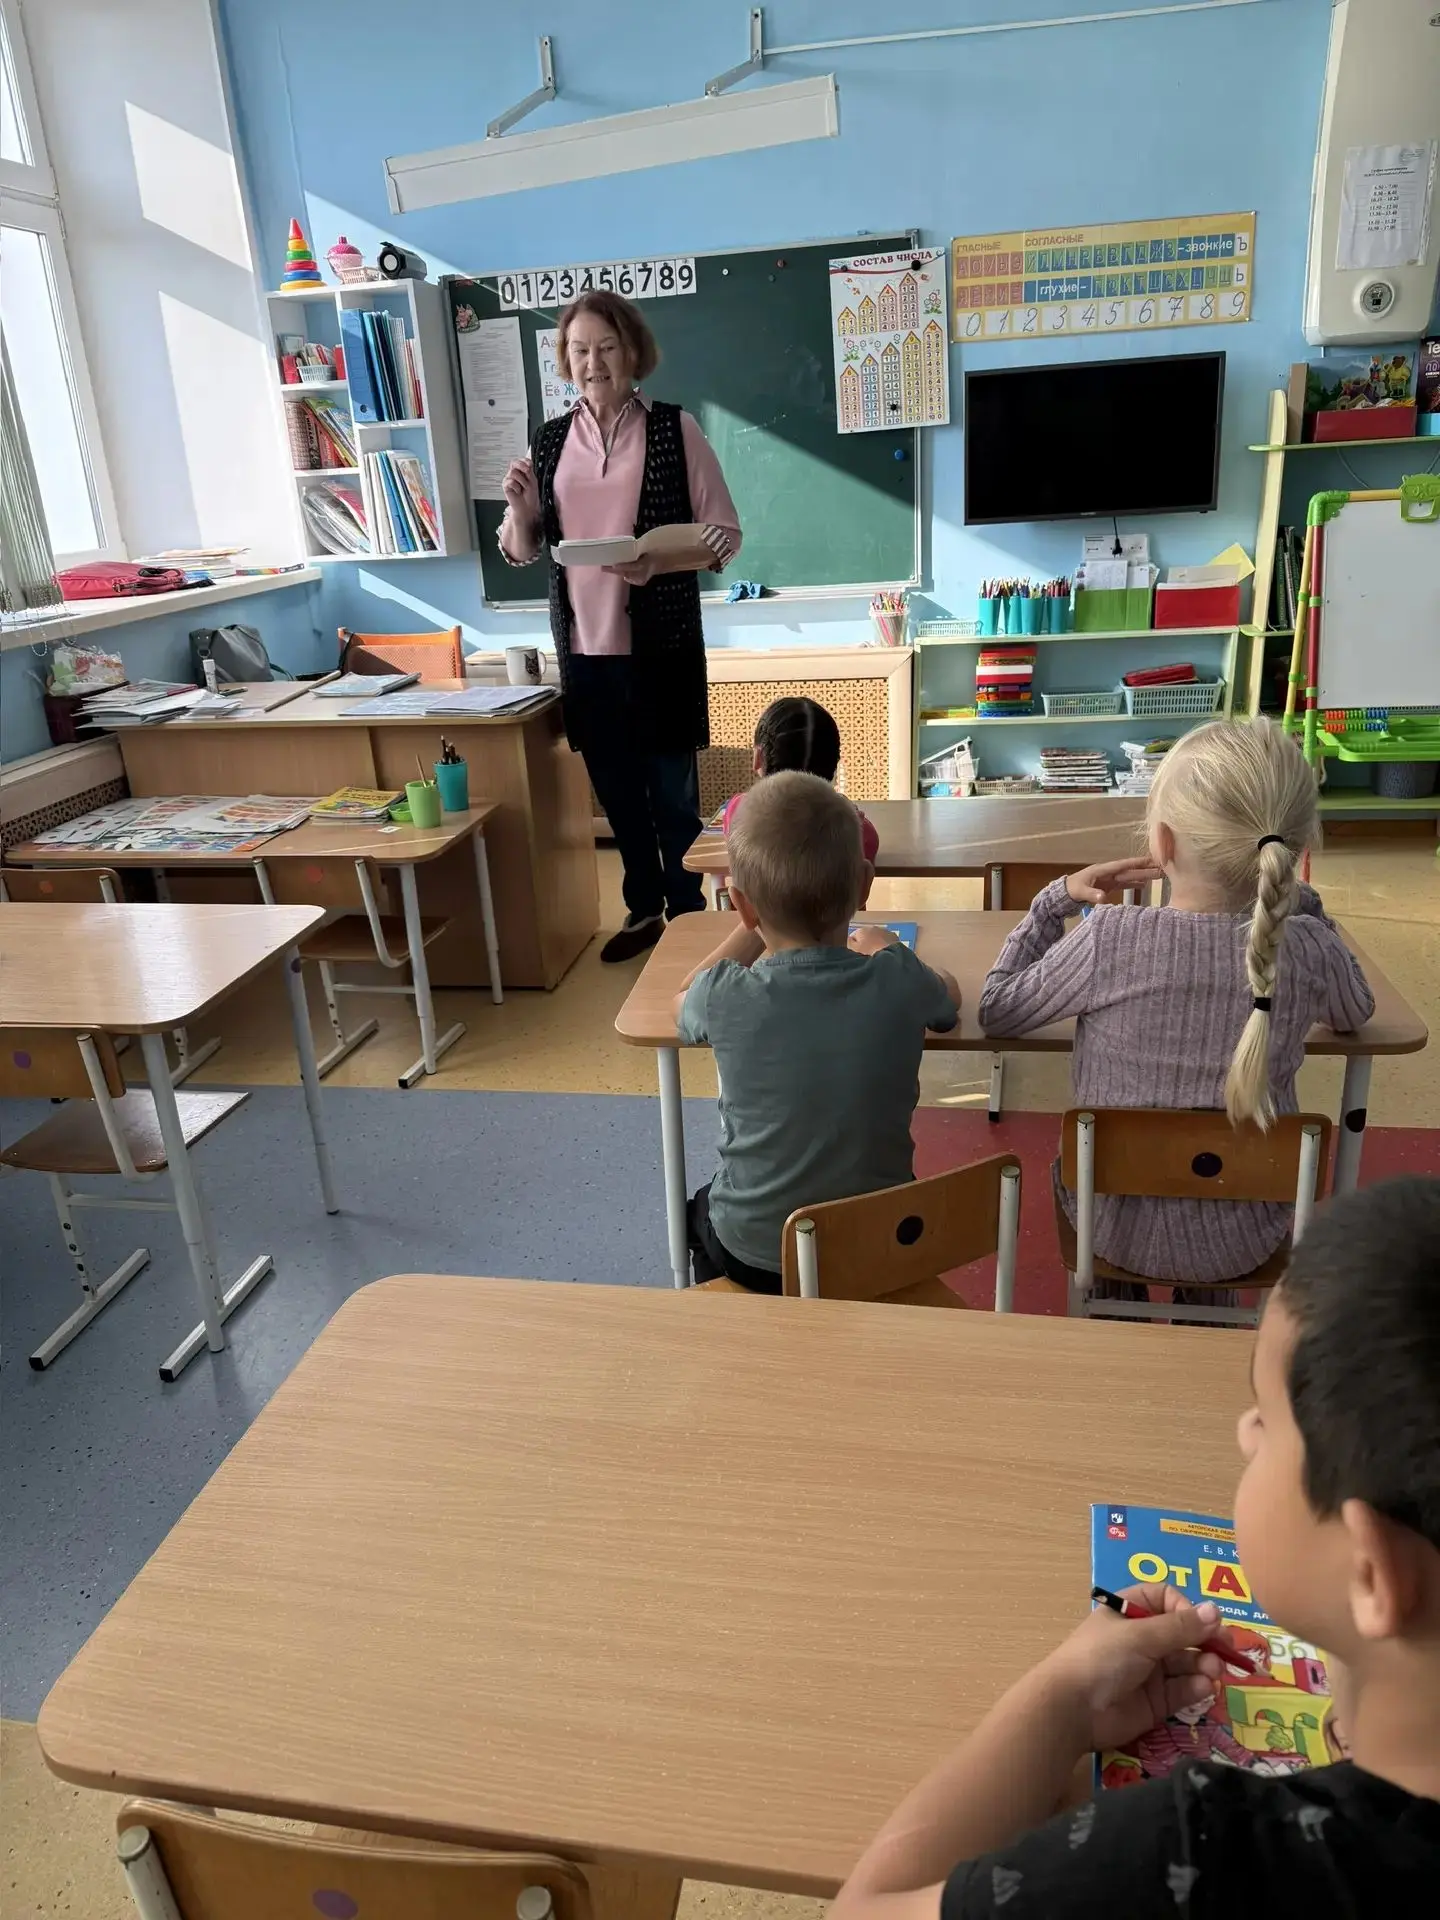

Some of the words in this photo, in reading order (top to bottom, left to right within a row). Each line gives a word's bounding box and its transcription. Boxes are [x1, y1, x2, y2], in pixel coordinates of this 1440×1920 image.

[957, 241, 1000, 253] ГЛАСНЫЕ
[1025, 234, 1084, 247] СОГЛАСНЫЕ
[1237, 237, 1247, 251] Ъ
[853, 255, 893, 267] СОСТАВ
[896, 251, 932, 262] ЧИСЛА
[1236, 268, 1244, 282] Ь
[966, 312, 981, 336] 0
[1000, 310, 1009, 333] 1
[1023, 308, 1038, 332] 2
[1053, 305, 1067, 329] 3
[1082, 303, 1095, 326] 4
[1105, 301, 1124, 325] 5
[1139, 299, 1155, 323] 6
[1168, 296, 1184, 321] 7
[1200, 294, 1214, 319] 8
[1229, 292, 1246, 316] 9
[1426, 341, 1440, 354] Те
[545, 381, 560, 396] Ёё
[1203, 1544, 1213, 1553] Е.
[1217, 1547, 1227, 1556] В.
[1128, 1552, 1192, 1587] От
[1206, 1565, 1247, 1598] А
[1218, 1605, 1248, 1616] радь
[1253, 1611, 1269, 1620] дл
